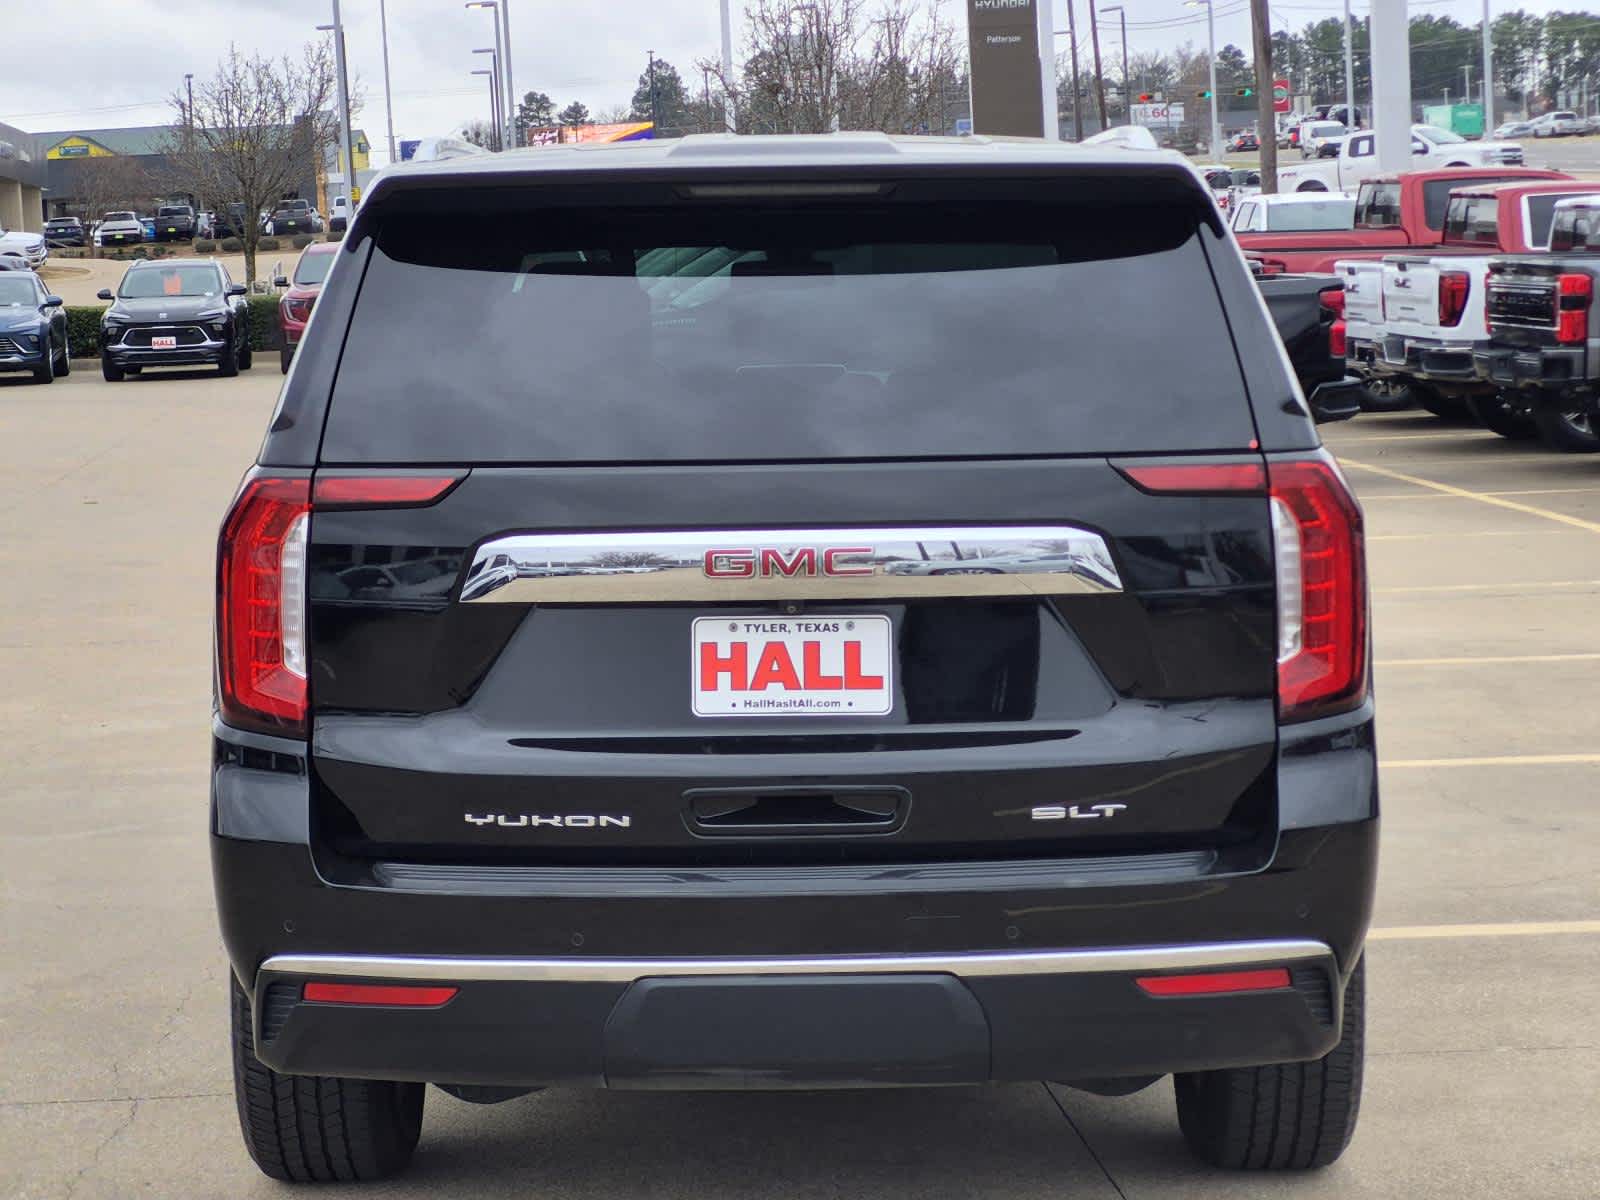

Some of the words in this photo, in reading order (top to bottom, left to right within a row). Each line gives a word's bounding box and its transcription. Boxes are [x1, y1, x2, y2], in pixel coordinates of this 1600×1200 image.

[986, 35, 1021, 44] Patterson
[703, 546, 875, 578] GMC
[744, 623, 792, 634] TYLER,
[796, 622, 840, 633] TEXAS
[700, 640, 884, 691] HALL
[743, 699, 841, 709] HallHasItAll.com
[1031, 804, 1127, 819] SLT
[464, 813, 631, 827] YUKON
